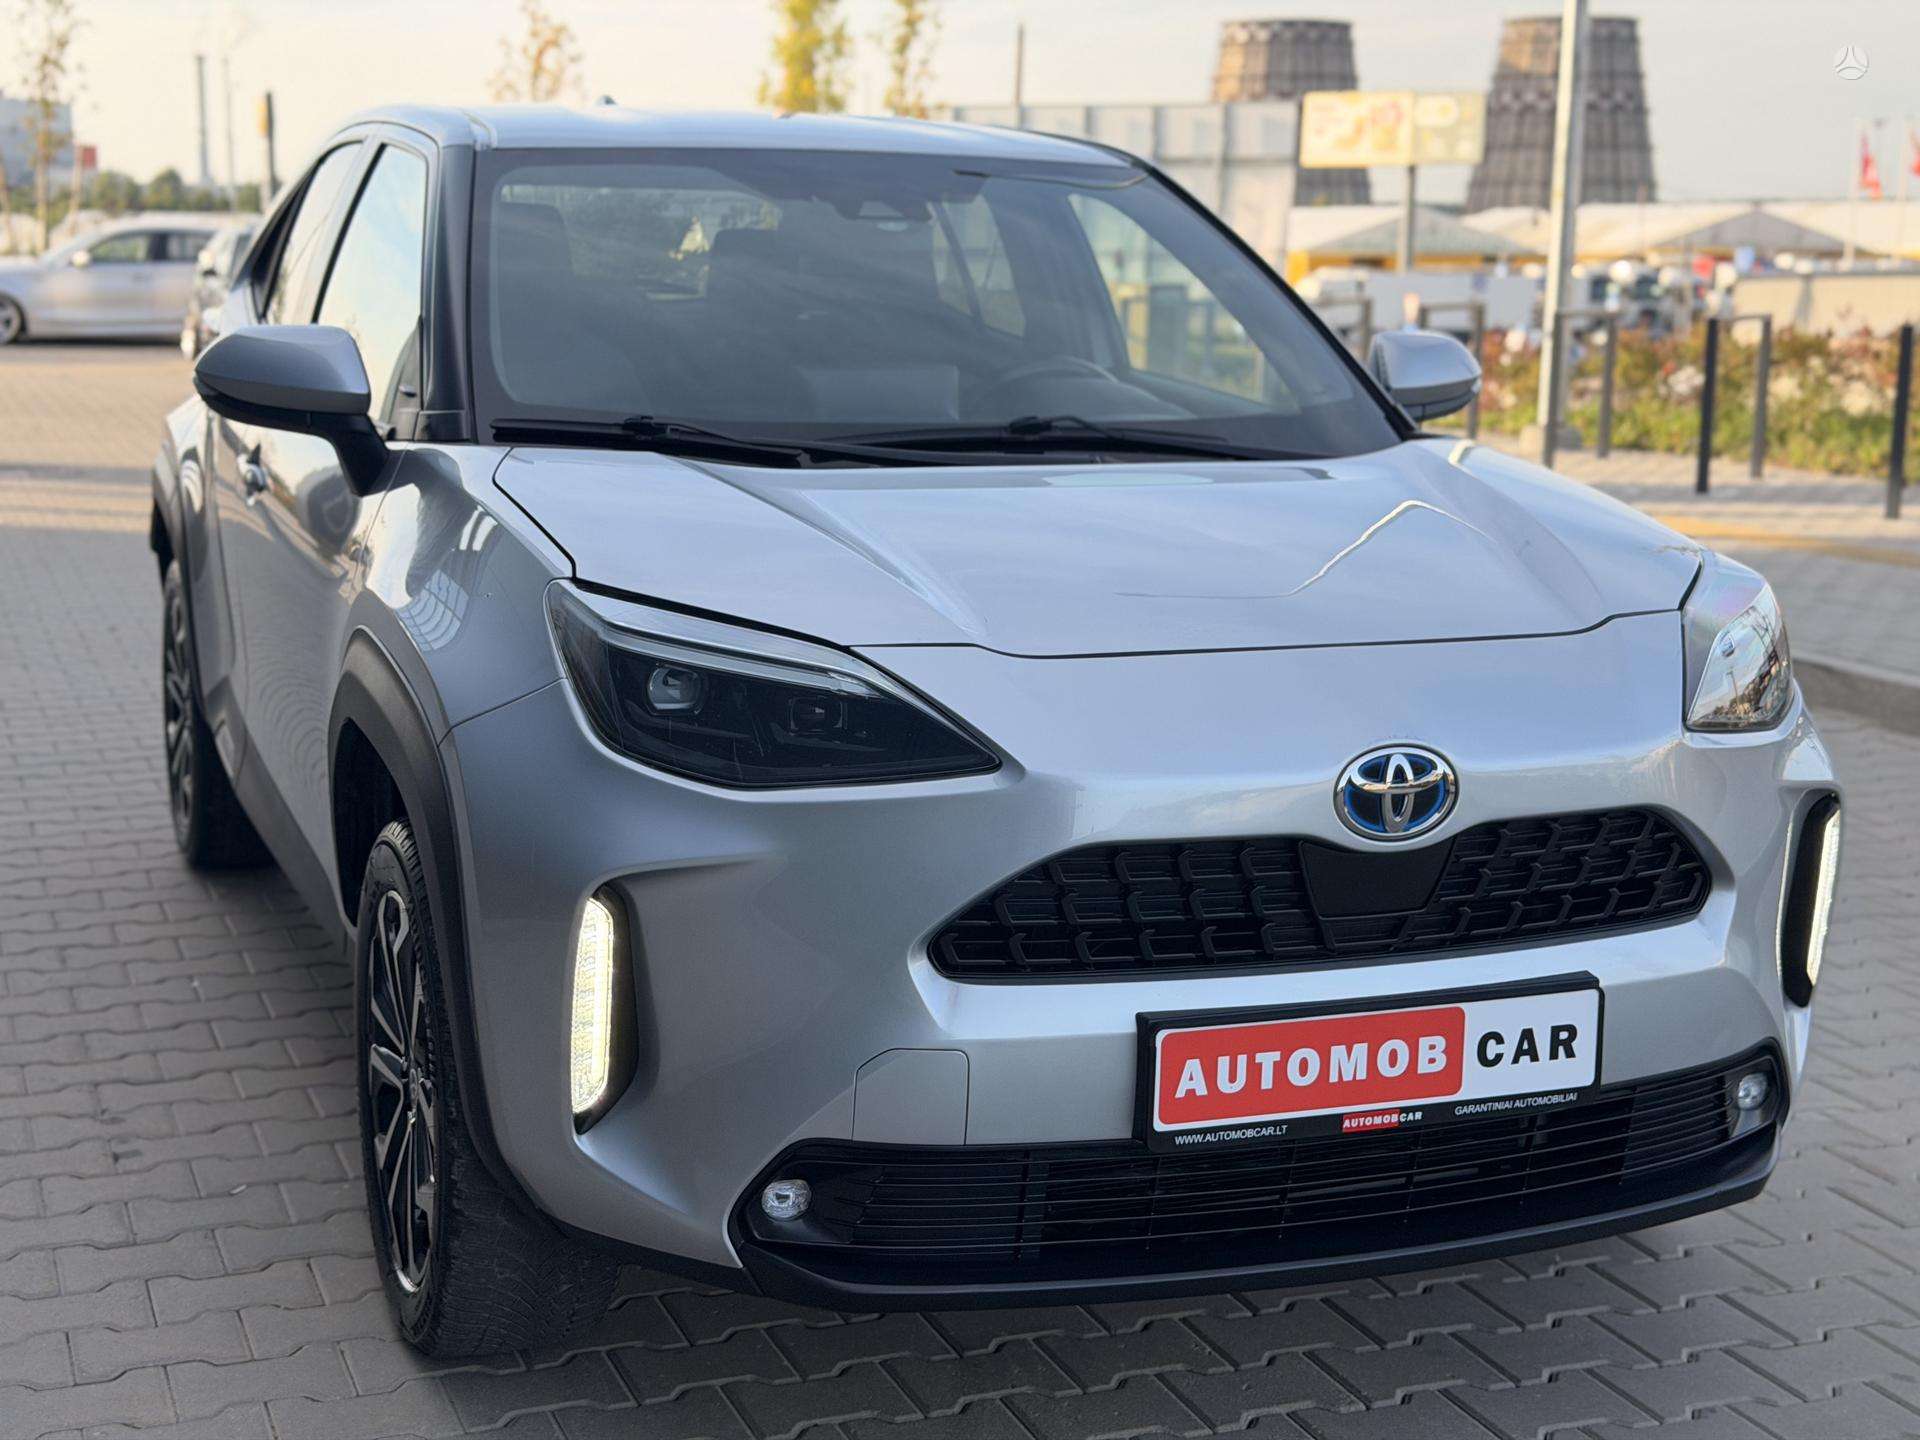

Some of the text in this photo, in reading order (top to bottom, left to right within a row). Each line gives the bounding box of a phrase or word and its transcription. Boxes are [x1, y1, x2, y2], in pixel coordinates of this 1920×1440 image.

[1174, 1023, 1578, 1098] AUTOMOB CAR
[1454, 1092, 1578, 1116] GARANTINIAI AUTOMOBILIAI
[1174, 1125, 1288, 1145] WWW.AUTOMOBCAR.LT
